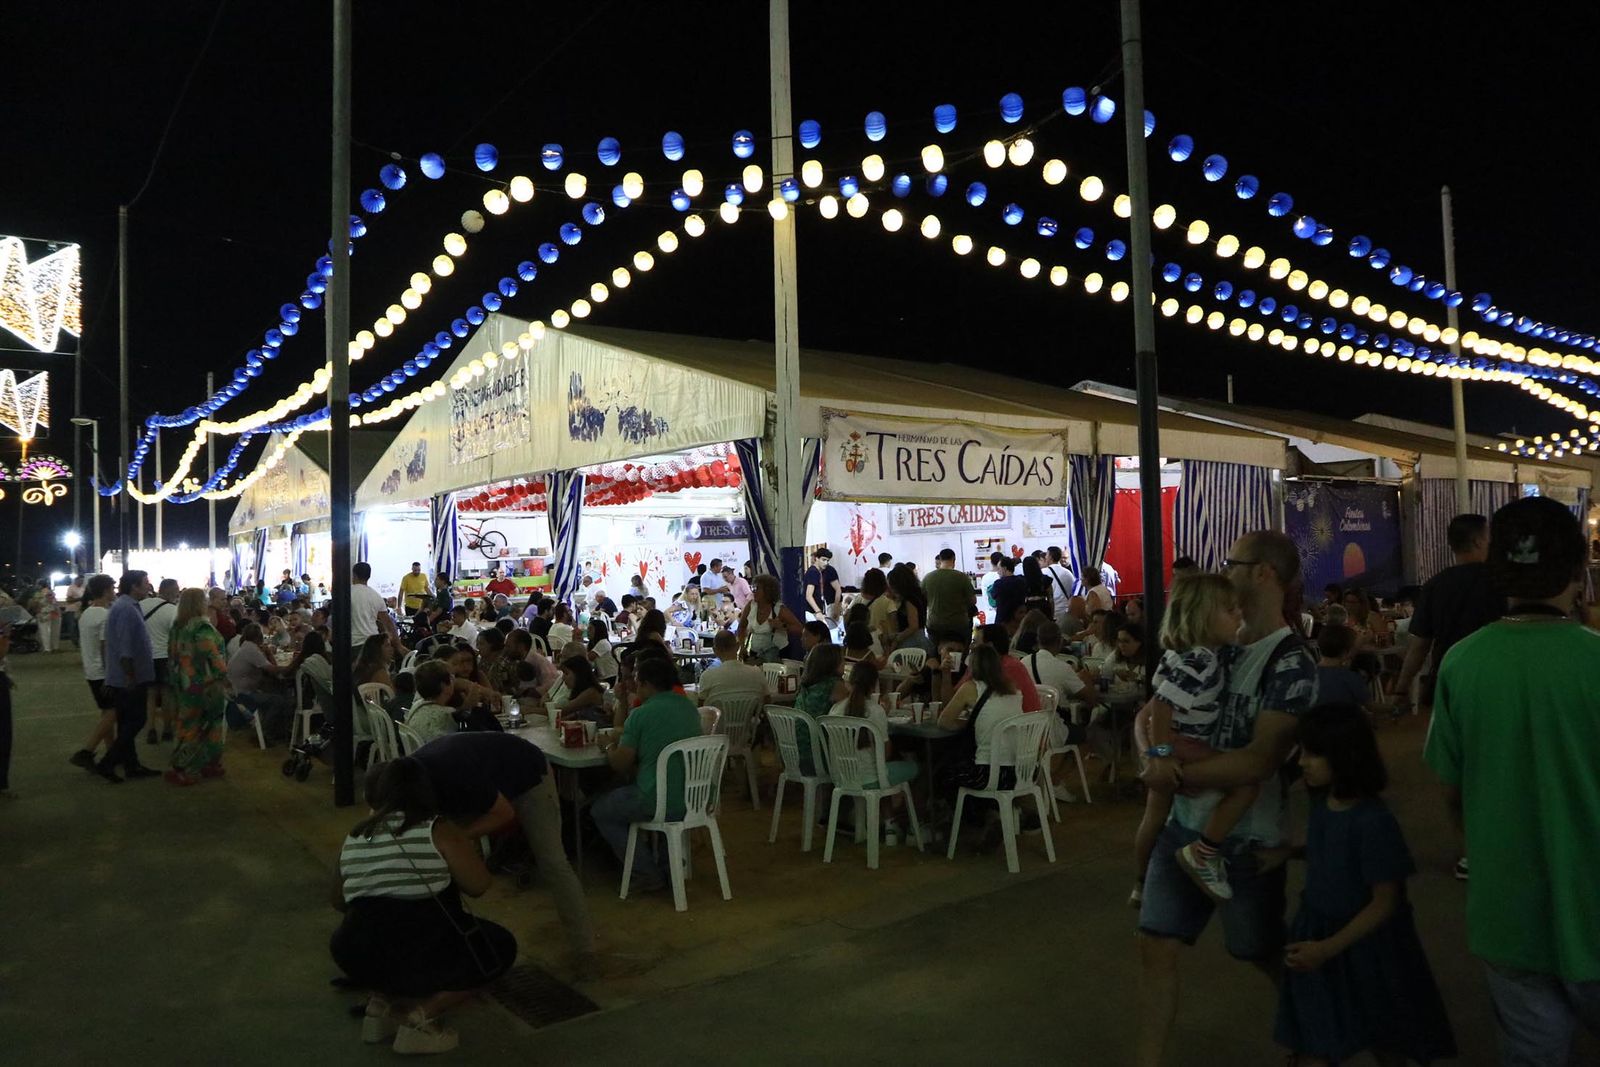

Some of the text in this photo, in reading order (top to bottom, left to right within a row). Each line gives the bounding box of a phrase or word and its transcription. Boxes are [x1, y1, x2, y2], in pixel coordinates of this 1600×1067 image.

[897, 434, 963, 446] HERMANDAD DE LAS
[866, 431, 1053, 487] TRES CAÍDAS
[908, 504, 945, 528] TRES
[702, 524, 730, 537] TRES
